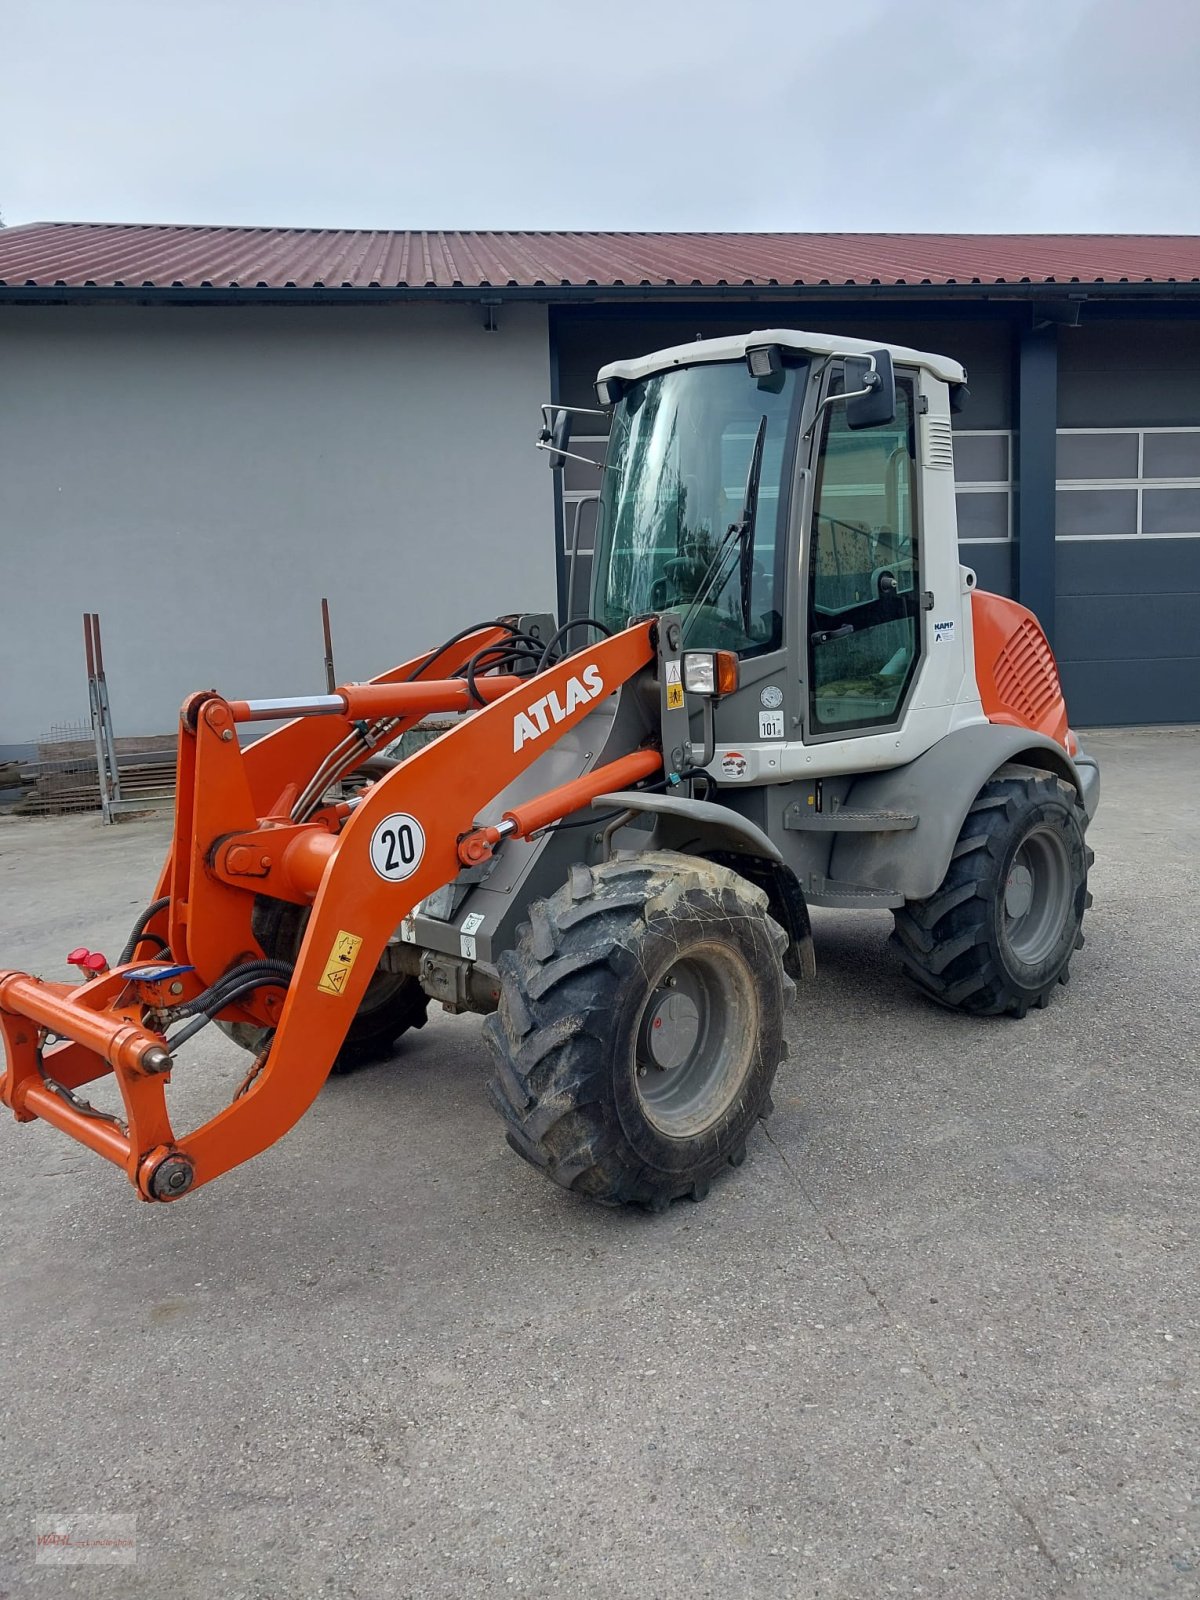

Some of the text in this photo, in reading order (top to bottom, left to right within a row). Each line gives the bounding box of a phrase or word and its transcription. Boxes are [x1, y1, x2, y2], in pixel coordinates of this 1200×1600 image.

[513, 664, 604, 753] ATLAS
[762, 722, 776, 736] 101
[381, 824, 415, 871] 20
